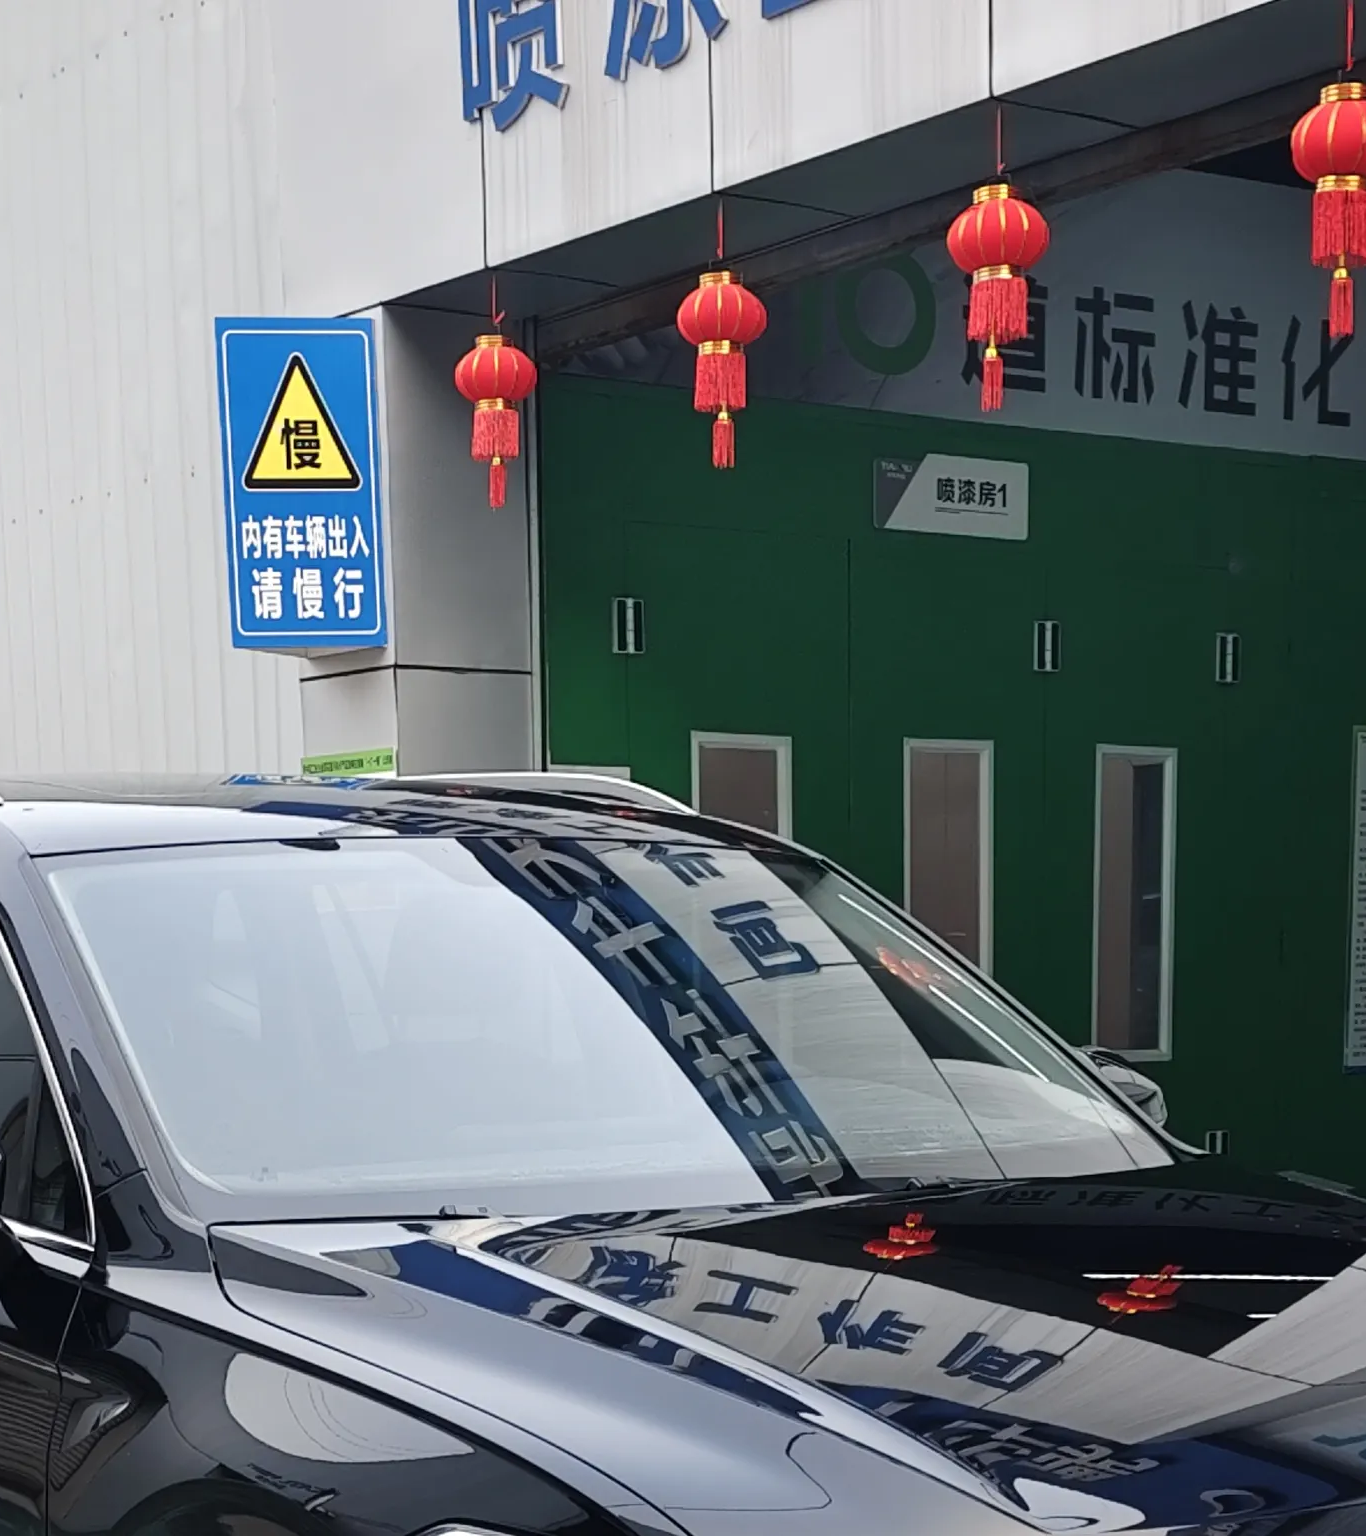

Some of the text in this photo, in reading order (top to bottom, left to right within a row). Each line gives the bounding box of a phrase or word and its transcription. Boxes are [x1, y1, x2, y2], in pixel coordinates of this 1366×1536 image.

[281, 418, 322, 470] 慢
[937, 477, 1007, 508] 喷漆房1
[241, 515, 370, 559] 内有车辆出入
[252, 567, 364, 619] 请慢行
